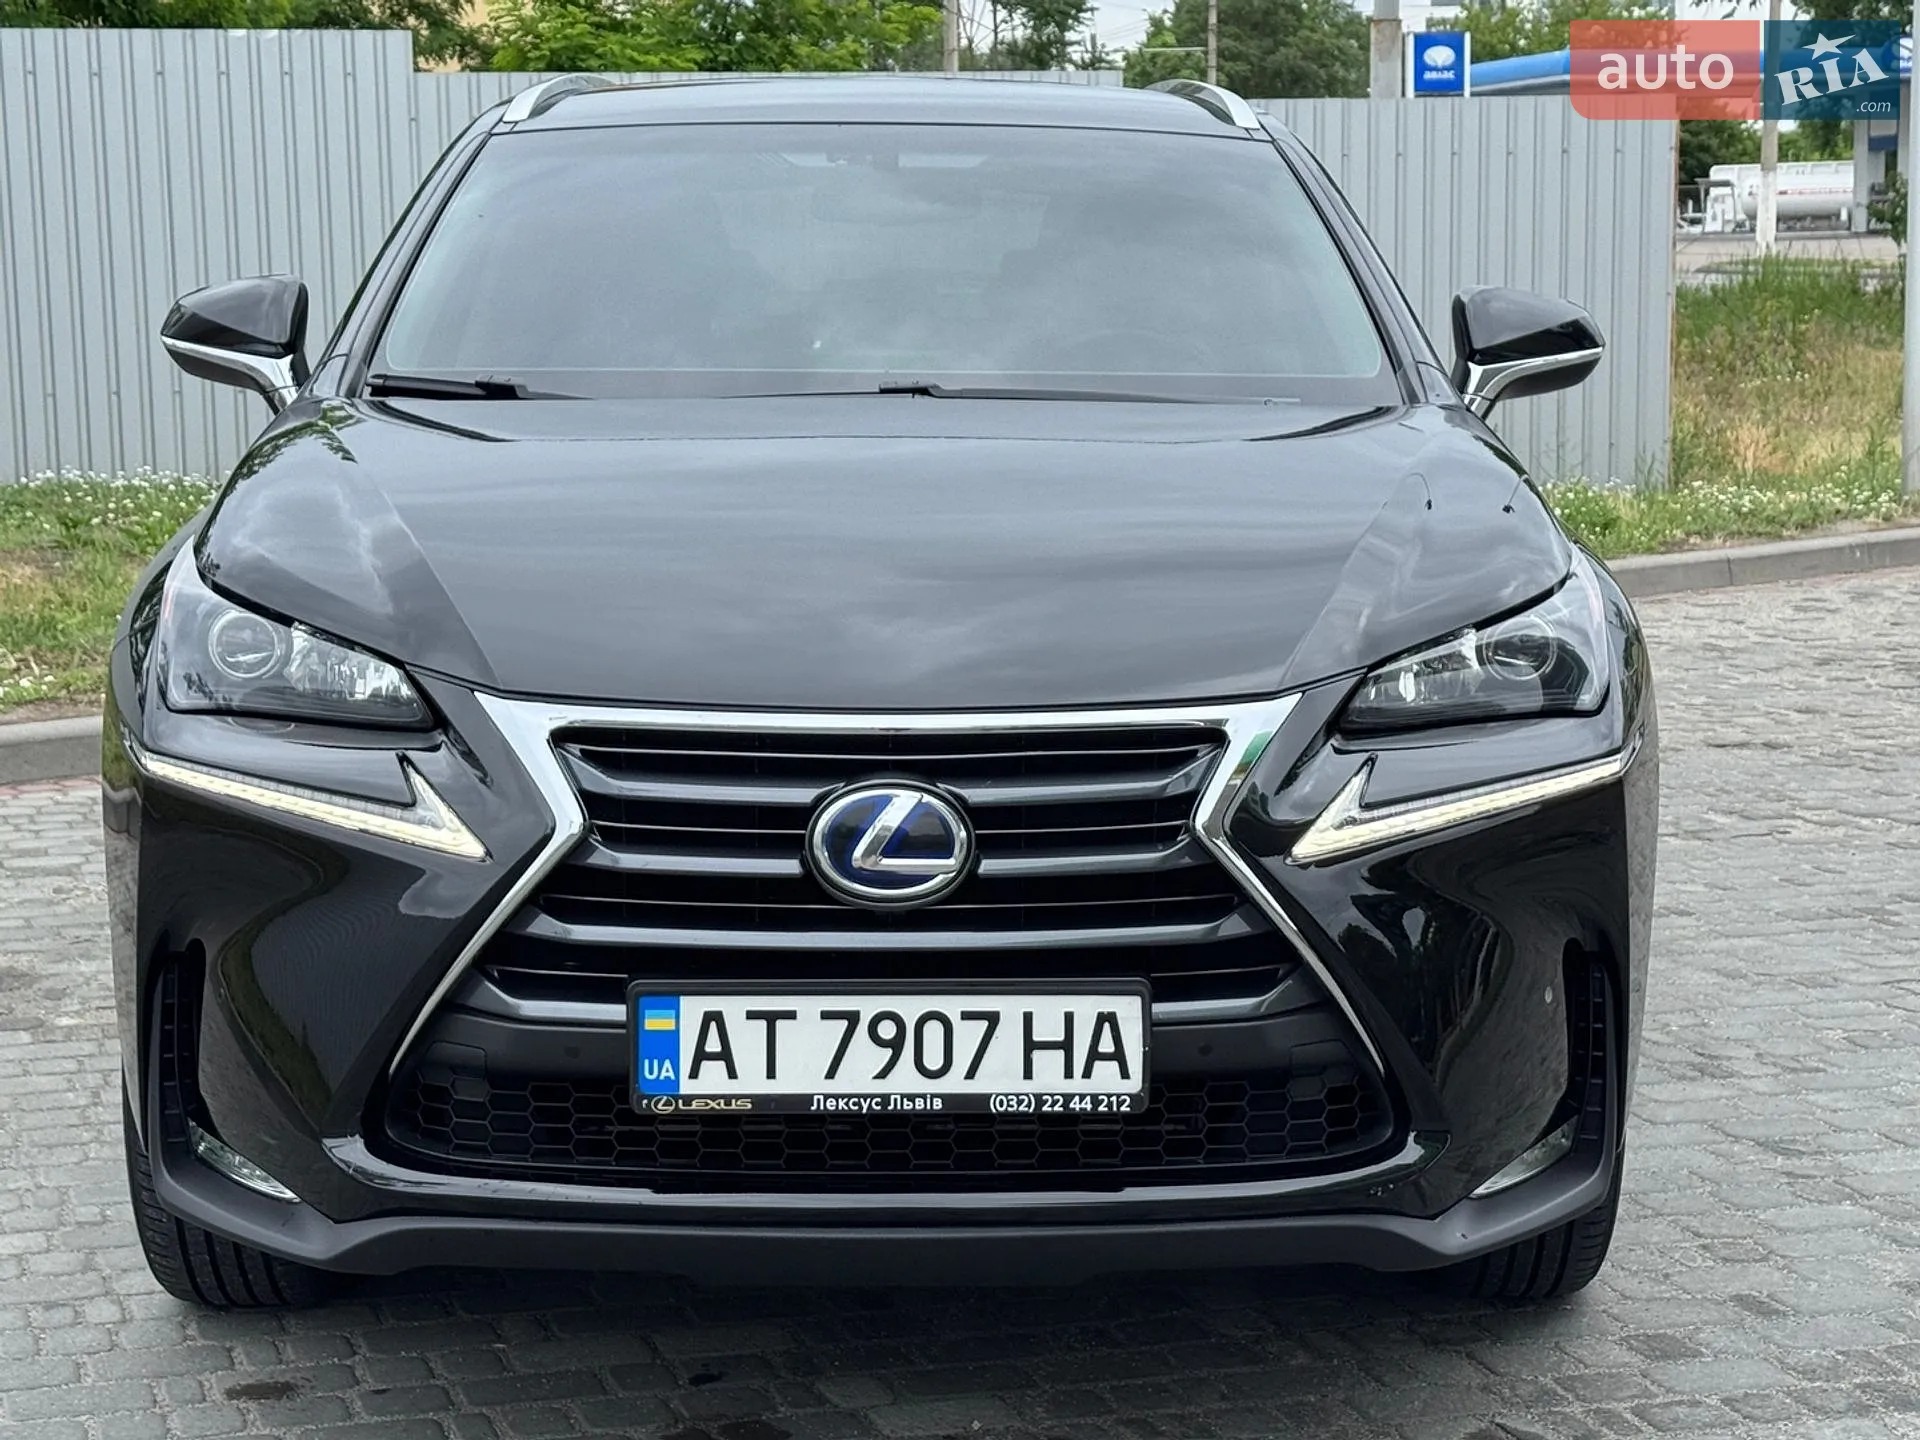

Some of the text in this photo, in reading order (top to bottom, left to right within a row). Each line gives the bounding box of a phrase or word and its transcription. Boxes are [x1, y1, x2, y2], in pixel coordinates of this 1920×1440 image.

[688, 1010, 1131, 1080] AT 7907 HA
[643, 1060, 675, 1080] UA
[678, 1098, 752, 1110] LEXUS
[810, 1094, 943, 1113] Лексус Львів
[989, 1094, 1131, 1113] (032) 22 44 212
